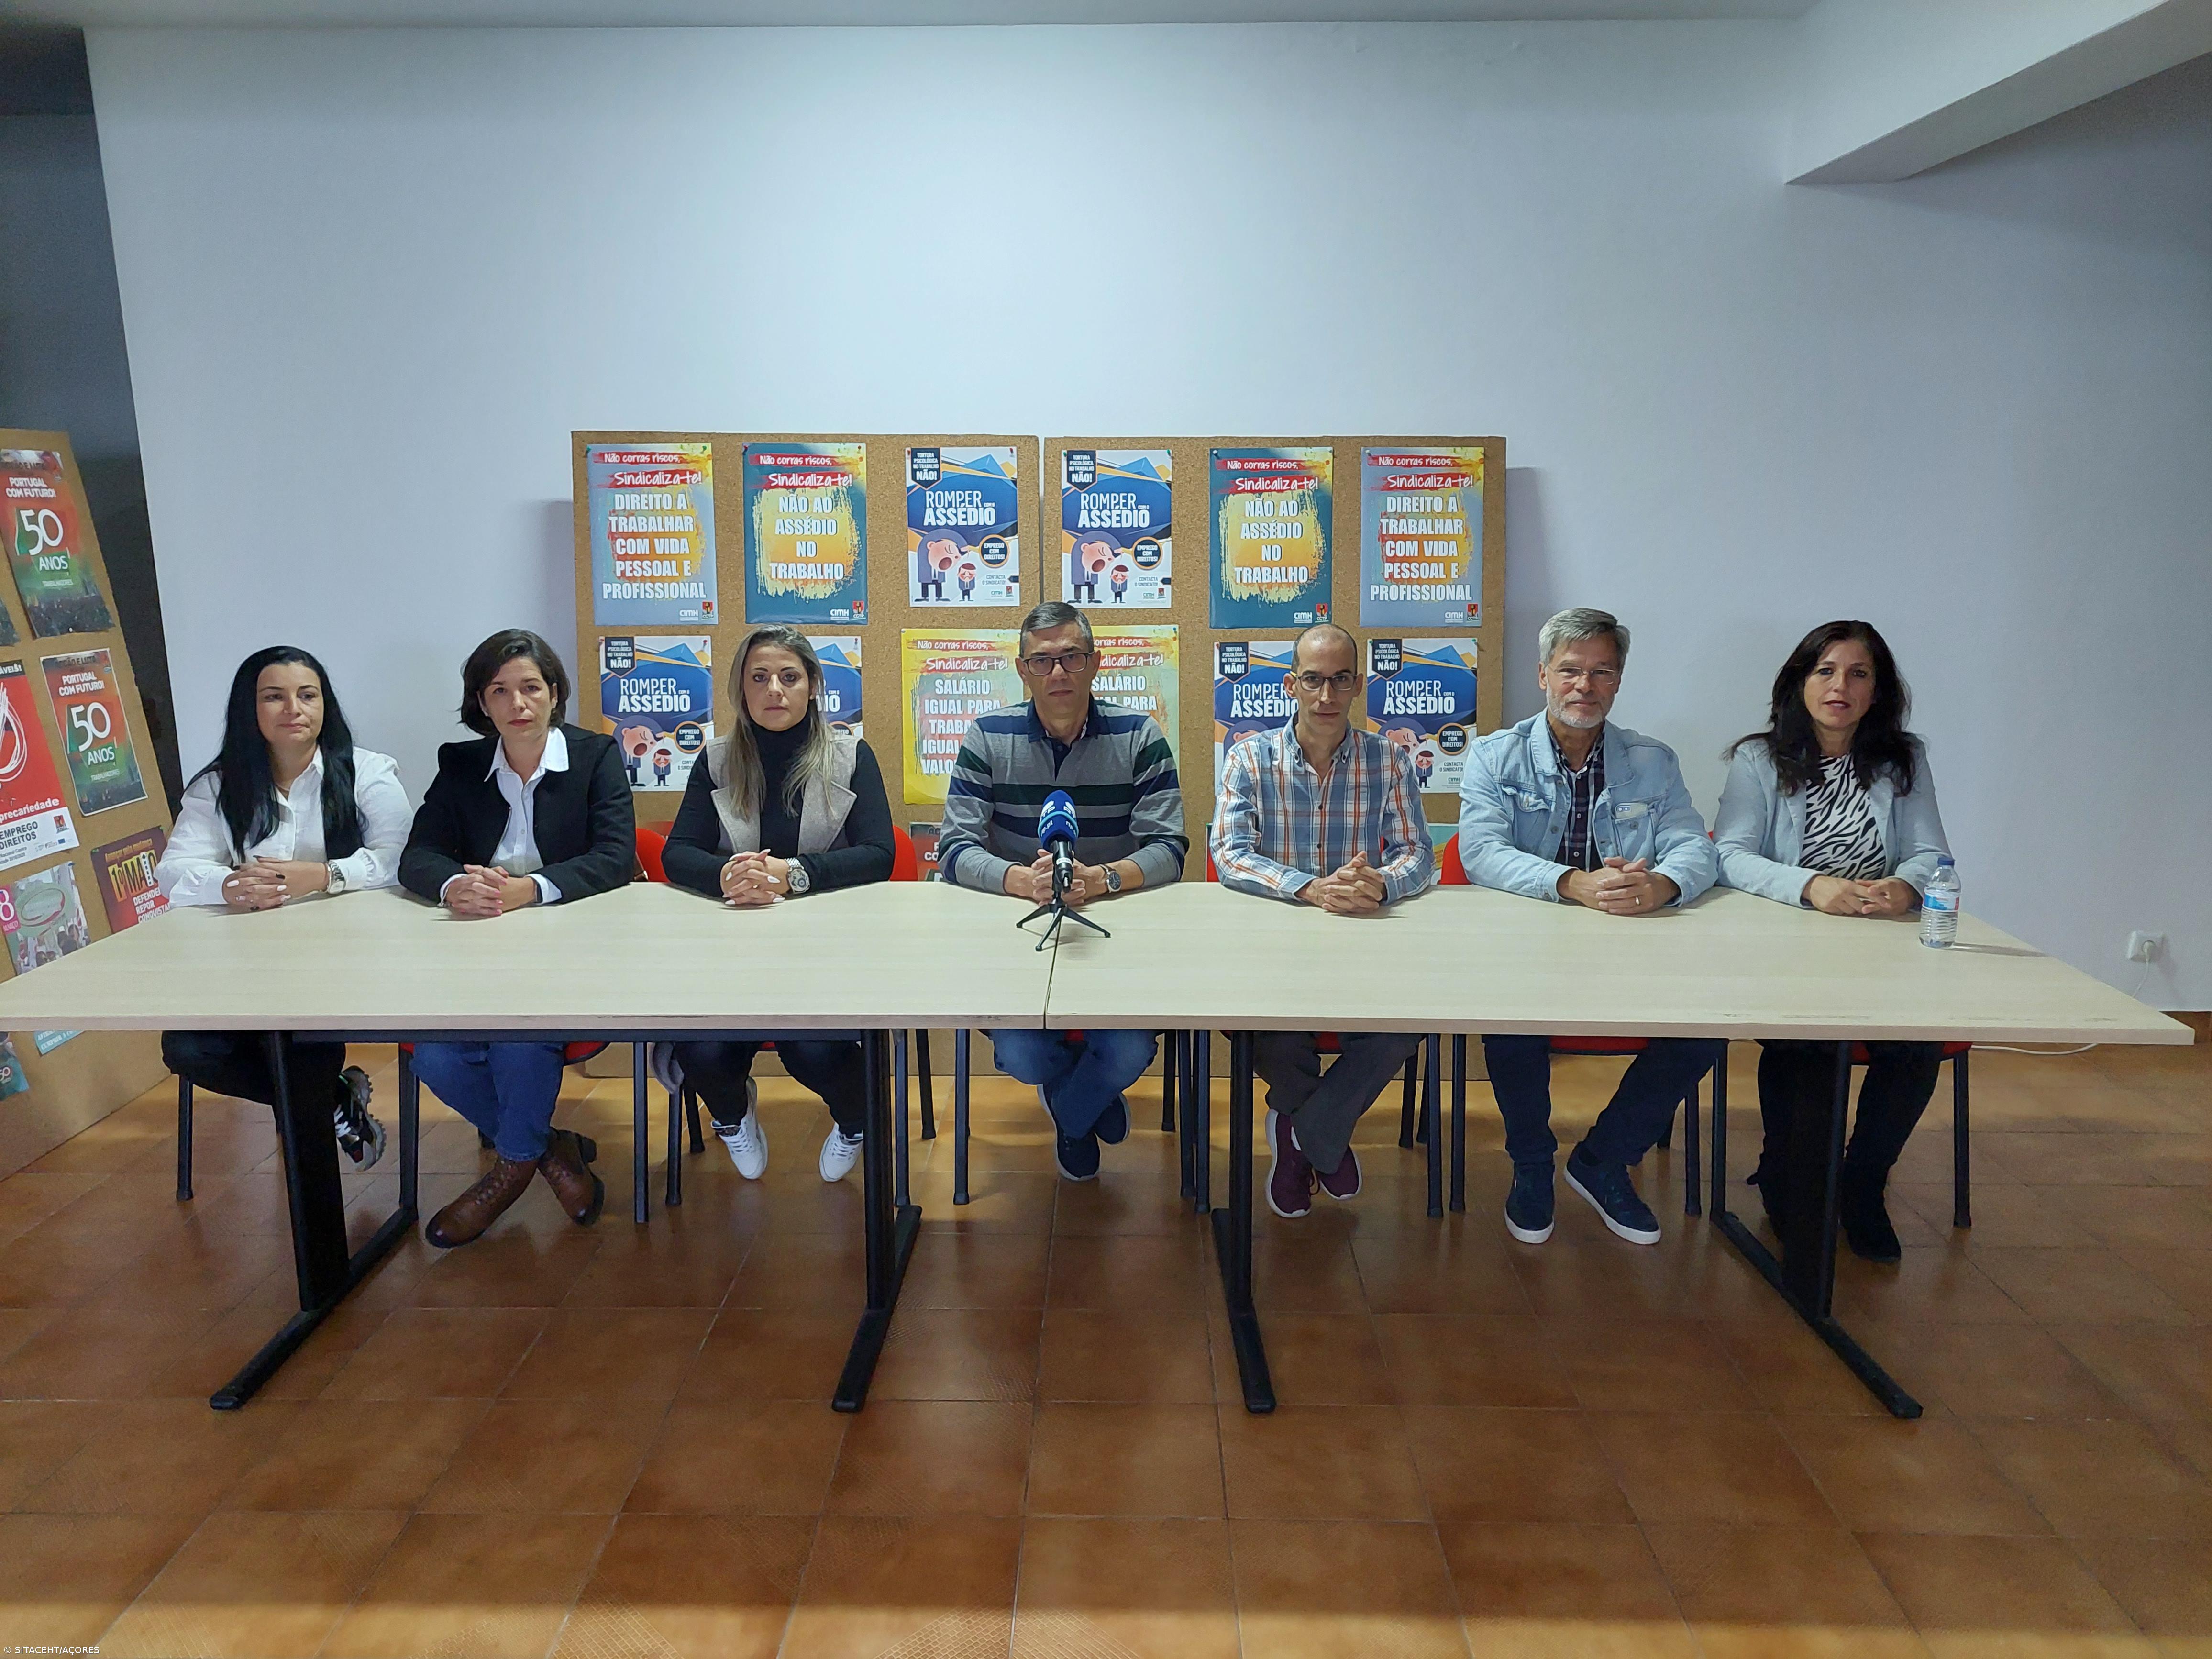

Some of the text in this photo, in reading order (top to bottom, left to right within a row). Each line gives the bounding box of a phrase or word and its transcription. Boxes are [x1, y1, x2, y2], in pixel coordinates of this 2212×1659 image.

[604, 453, 620, 463] Não
[622, 454, 650, 463] corras
[760, 455, 774, 464] Não
[1227, 461, 1241, 469] Não
[1379, 456, 1394, 465] Não
[1396, 458, 1423, 466] corras
[9, 477, 48, 487] PORTUGAL
[614, 470, 702, 485] Sindicaliza-te!
[768, 473, 852, 487] Sindicaliza-te!
[916, 469, 937, 480] NÃO!
[1072, 471, 1092, 483] NÃO!
[1387, 474, 1473, 488] Sindicaliza-te!
[1235, 477, 1318, 491] Sindicaliza-te!
[6, 488, 24, 498] COM
[926, 491, 982, 508] ROMPER
[615, 493, 687, 510] DIREITO A
[779, 494, 833, 513] NÃO AO
[1081, 493, 1136, 510] ROMPER
[1245, 498, 1299, 517] NÃO AO
[1387, 496, 1458, 513] DIREITO A
[924, 503, 996, 526] ASSÉDIO
[1078, 505, 1150, 528] ASSÉDIO
[608, 516, 694, 532] TRABALHAR
[775, 516, 837, 535] ASSÉDIO
[1240, 520, 1303, 539] ASSÉDIO
[1380, 519, 1464, 535] TRABALHAR
[20, 509, 64, 556] 50
[616, 538, 690, 555] COM VIDA
[796, 541, 817, 557] NO
[1261, 545, 1282, 561] NO
[1385, 541, 1458, 557] COM VIDA
[39, 555, 68, 571] ANOS
[616, 560, 692, 577] PESSOAL E
[770, 563, 844, 579] TRABALHO
[1384, 563, 1459, 579] PESSOAL E
[1234, 566, 1308, 583] TRABALHO
[603, 582, 707, 599] PROFISSIONAL
[1371, 585, 1472, 601] PROFISSIONAL
[918, 640, 932, 649] Não
[610, 657, 631, 668] NÃO!
[926, 658, 1008, 670] Sindicaliza-te!
[1225, 663, 1244, 674] NÃO!
[1377, 660, 1397, 671] NÃO!
[62, 671, 97, 685] PORTUGAL
[935, 677, 991, 694] SALÁRIO
[1091, 674, 1146, 691] SALÁRIO
[59, 686, 76, 696] COM
[620, 678, 676, 695] ROMPER
[1234, 683, 1288, 700] ROMPER
[1386, 680, 1441, 697] ROMPER
[618, 690, 690, 712] ASSÉDIO
[925, 699, 1001, 714] IGUAL PARA
[1123, 696, 1157, 710] PARA
[1230, 695, 1299, 718] ASSÉDIO
[1383, 692, 1455, 715] ASSÉDIO
[71, 702, 111, 752] 50
[929, 719, 971, 734] TRABA
[923, 740, 960, 754] IGUAL
[88, 746, 115, 765] ANOS
[922, 759, 956, 774] VALO
[0, 798, 60, 823] precariedade
[0, 821, 38, 840] EMPREGO
[0, 831, 37, 850] DIREITOS
[924, 852, 939, 861] CO
[0, 889, 14, 921] 8
[135, 900, 155, 915] REPOR
